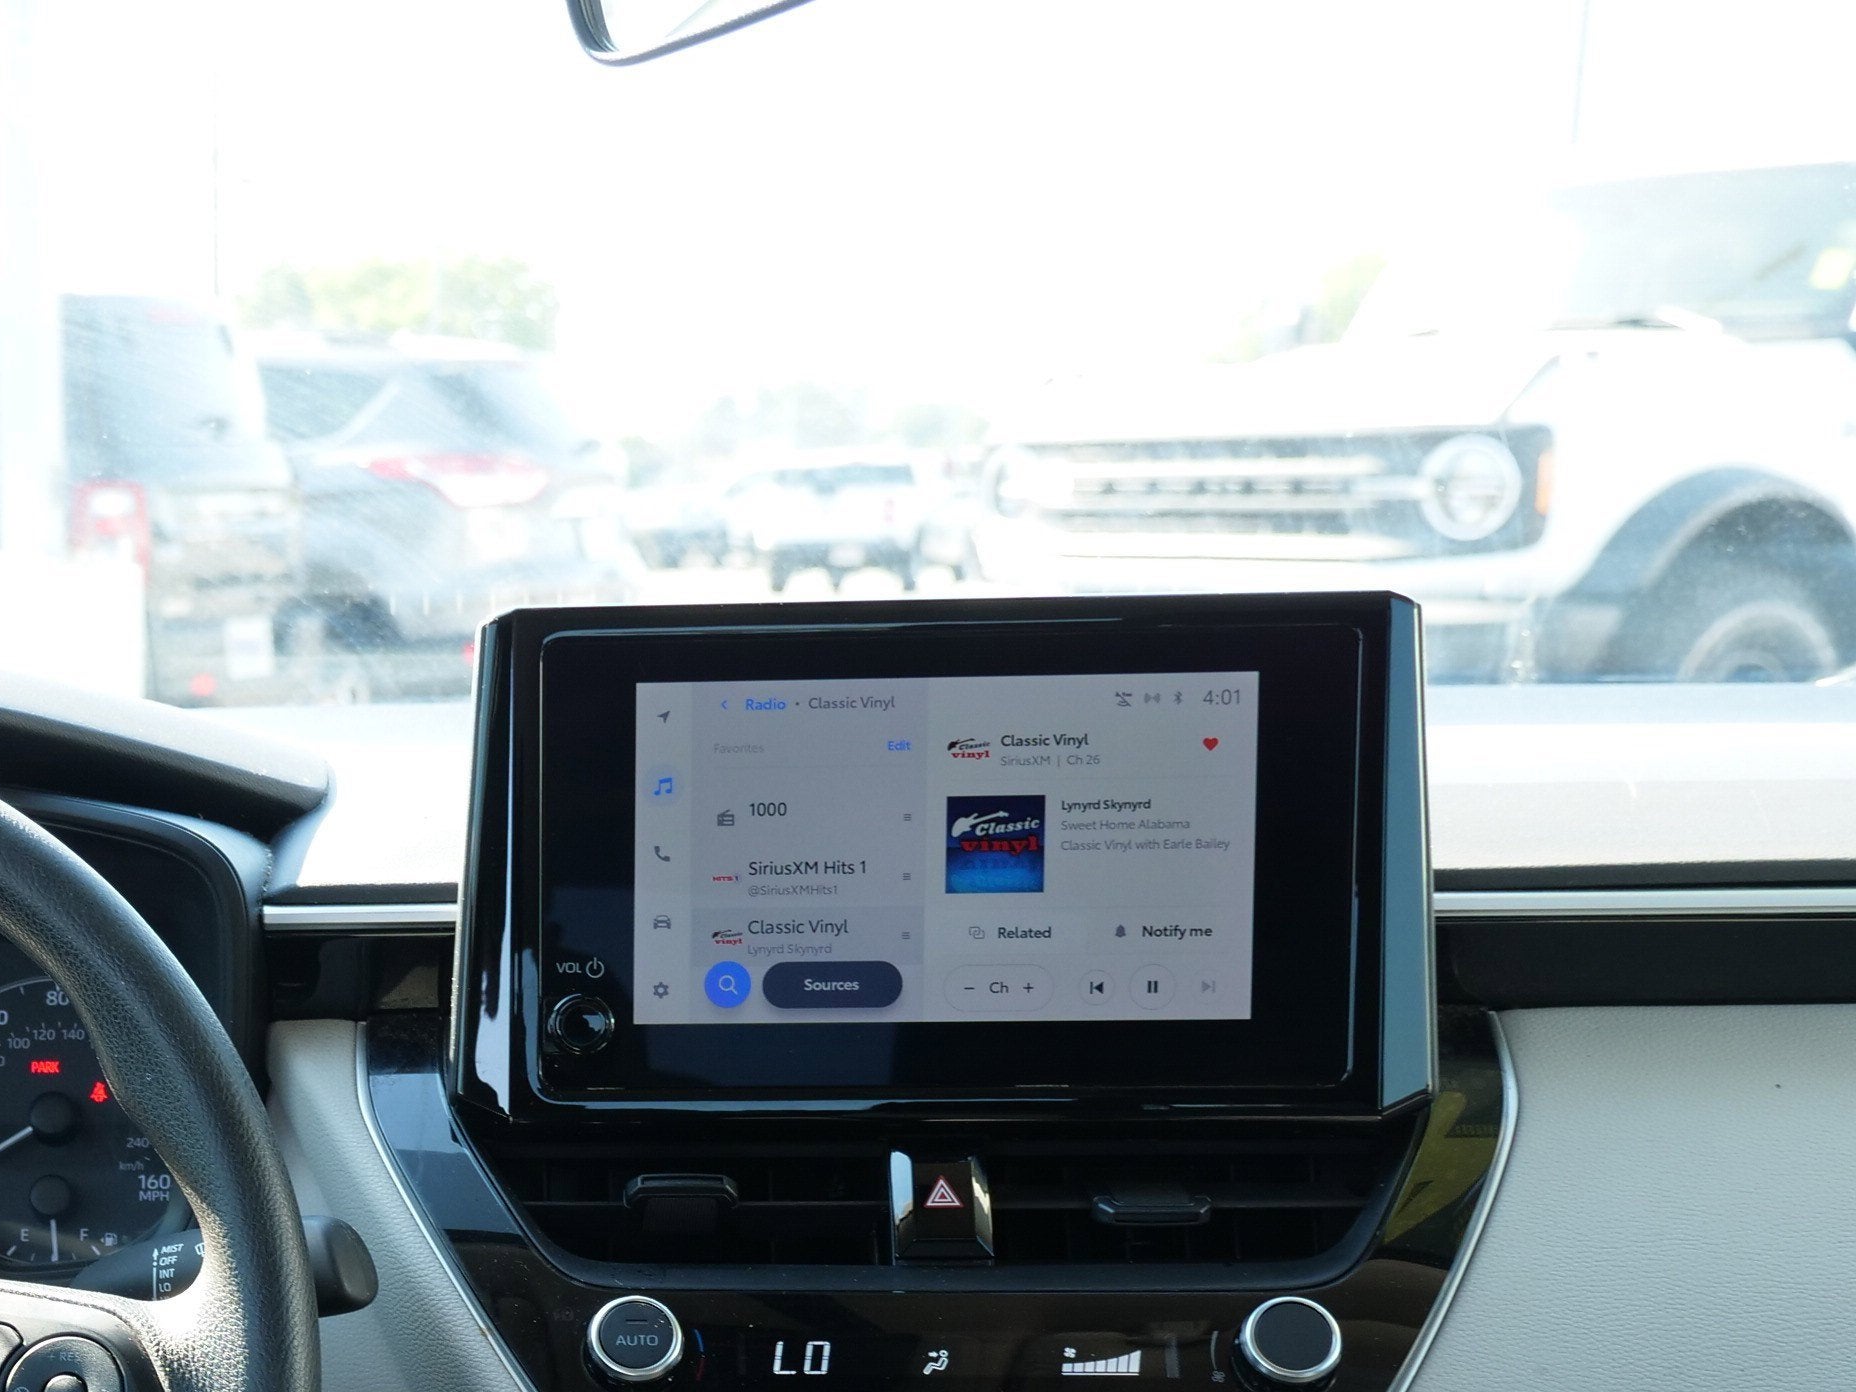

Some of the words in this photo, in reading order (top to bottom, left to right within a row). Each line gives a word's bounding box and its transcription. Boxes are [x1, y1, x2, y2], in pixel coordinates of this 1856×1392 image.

[745, 698, 786, 711] Radio
[808, 697, 858, 709] Classic
[860, 696, 896, 711] Vinyl
[1202, 689, 1241, 706] 4:01
[887, 740, 911, 751] Edit
[1000, 734, 1050, 747] Classic
[1052, 733, 1089, 748] Vinyl
[713, 743, 765, 753] Favorites
[951, 750, 990, 760] vinyl
[1000, 755, 1051, 767] SiriusXM
[1066, 755, 1082, 765] Ch
[1086, 754, 1101, 765] 26
[748, 802, 788, 817] 1000
[1061, 800, 1101, 813] Lynyrd
[1102, 799, 1152, 812] Skynyrd
[974, 816, 1041, 837] Classic
[1060, 820, 1097, 831] Sweet
[1099, 820, 1136, 830] Home
[1137, 818, 1191, 830] Alabama
[960, 835, 1039, 856] vinyl
[1060, 839, 1101, 851] Classic
[1104, 839, 1132, 853] Vinyl
[1134, 839, 1160, 850] with
[1163, 838, 1193, 849] Earle
[1195, 837, 1231, 852] Bailey
[748, 861, 819, 876] SiriusXM
[823, 861, 855, 875] Hits
[860, 860, 867, 874] 1
[748, 885, 838, 897] @SiriusXMHits1
[747, 920, 805, 934] Classic
[808, 919, 849, 937] Vinyl
[998, 926, 1052, 939] Related
[1142, 924, 1187, 941] Notify
[1189, 927, 1213, 937] me
[747, 944, 784, 957] Lynyrd
[787, 943, 833, 957] Skynyrd
[555, 962, 582, 973] VOL
[803, 978, 860, 991] Sources
[989, 981, 1009, 994] Ch
[32, 1029, 56, 1040] 120
[61, 1029, 86, 1040] 140
[8, 1038, 31, 1049] 100
[30, 1060, 60, 1074] PARK
[126, 1137, 150, 1148] 240
[118, 1160, 145, 1171] km/h
[138, 1174, 171, 1190] 160
[138, 1190, 170, 1202] MPH
[20, 1229, 29, 1242] E
[80, 1228, 89, 1241] F
[160, 1243, 185, 1254] MIST
[158, 1255, 178, 1266] OFF
[158, 1268, 175, 1279] INT
[158, 1282, 172, 1293] LO
[615, 1334, 659, 1346] AUTO
[772, 1340, 832, 1375] LO
